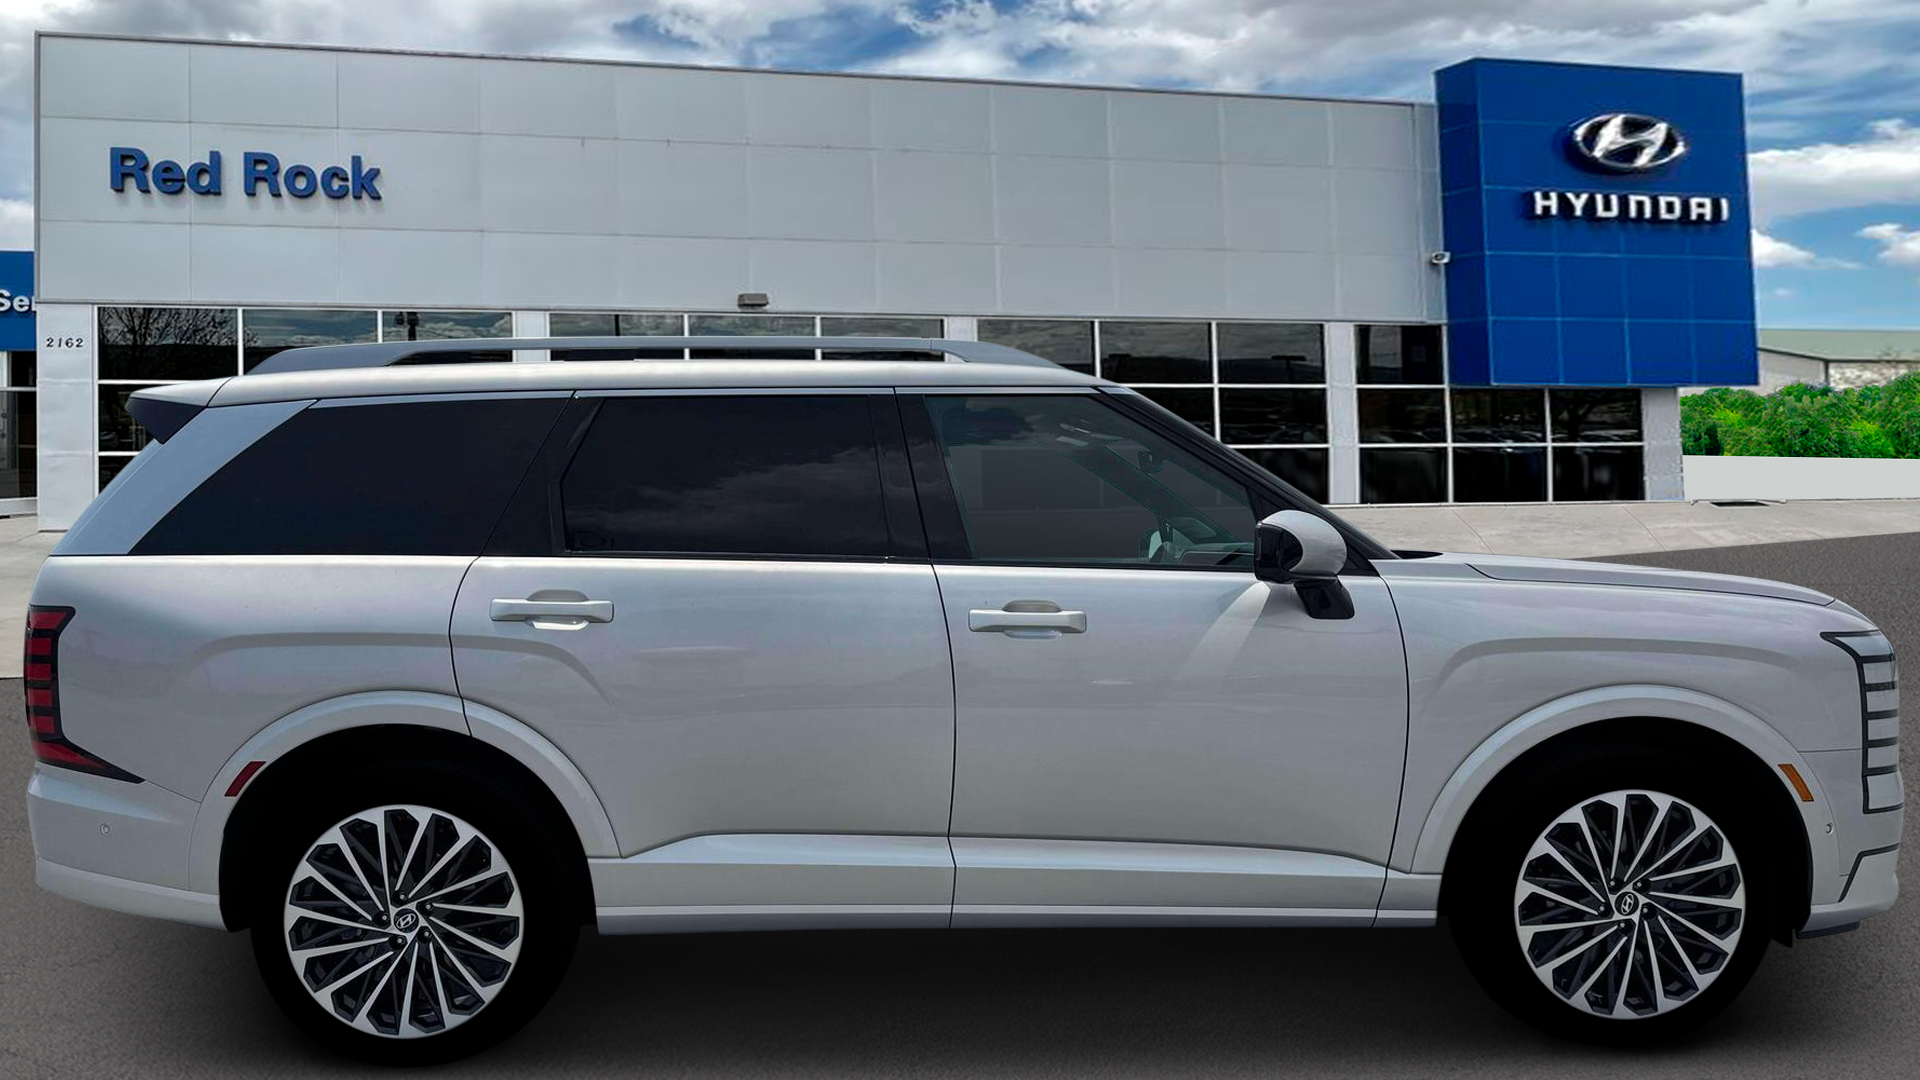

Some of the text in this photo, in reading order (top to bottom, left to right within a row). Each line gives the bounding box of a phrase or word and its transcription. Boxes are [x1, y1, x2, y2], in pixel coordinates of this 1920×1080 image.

[110, 147, 382, 200] Red Rock
[1534, 191, 1729, 221] HYUNDAI
[46, 337, 84, 348] 2162
